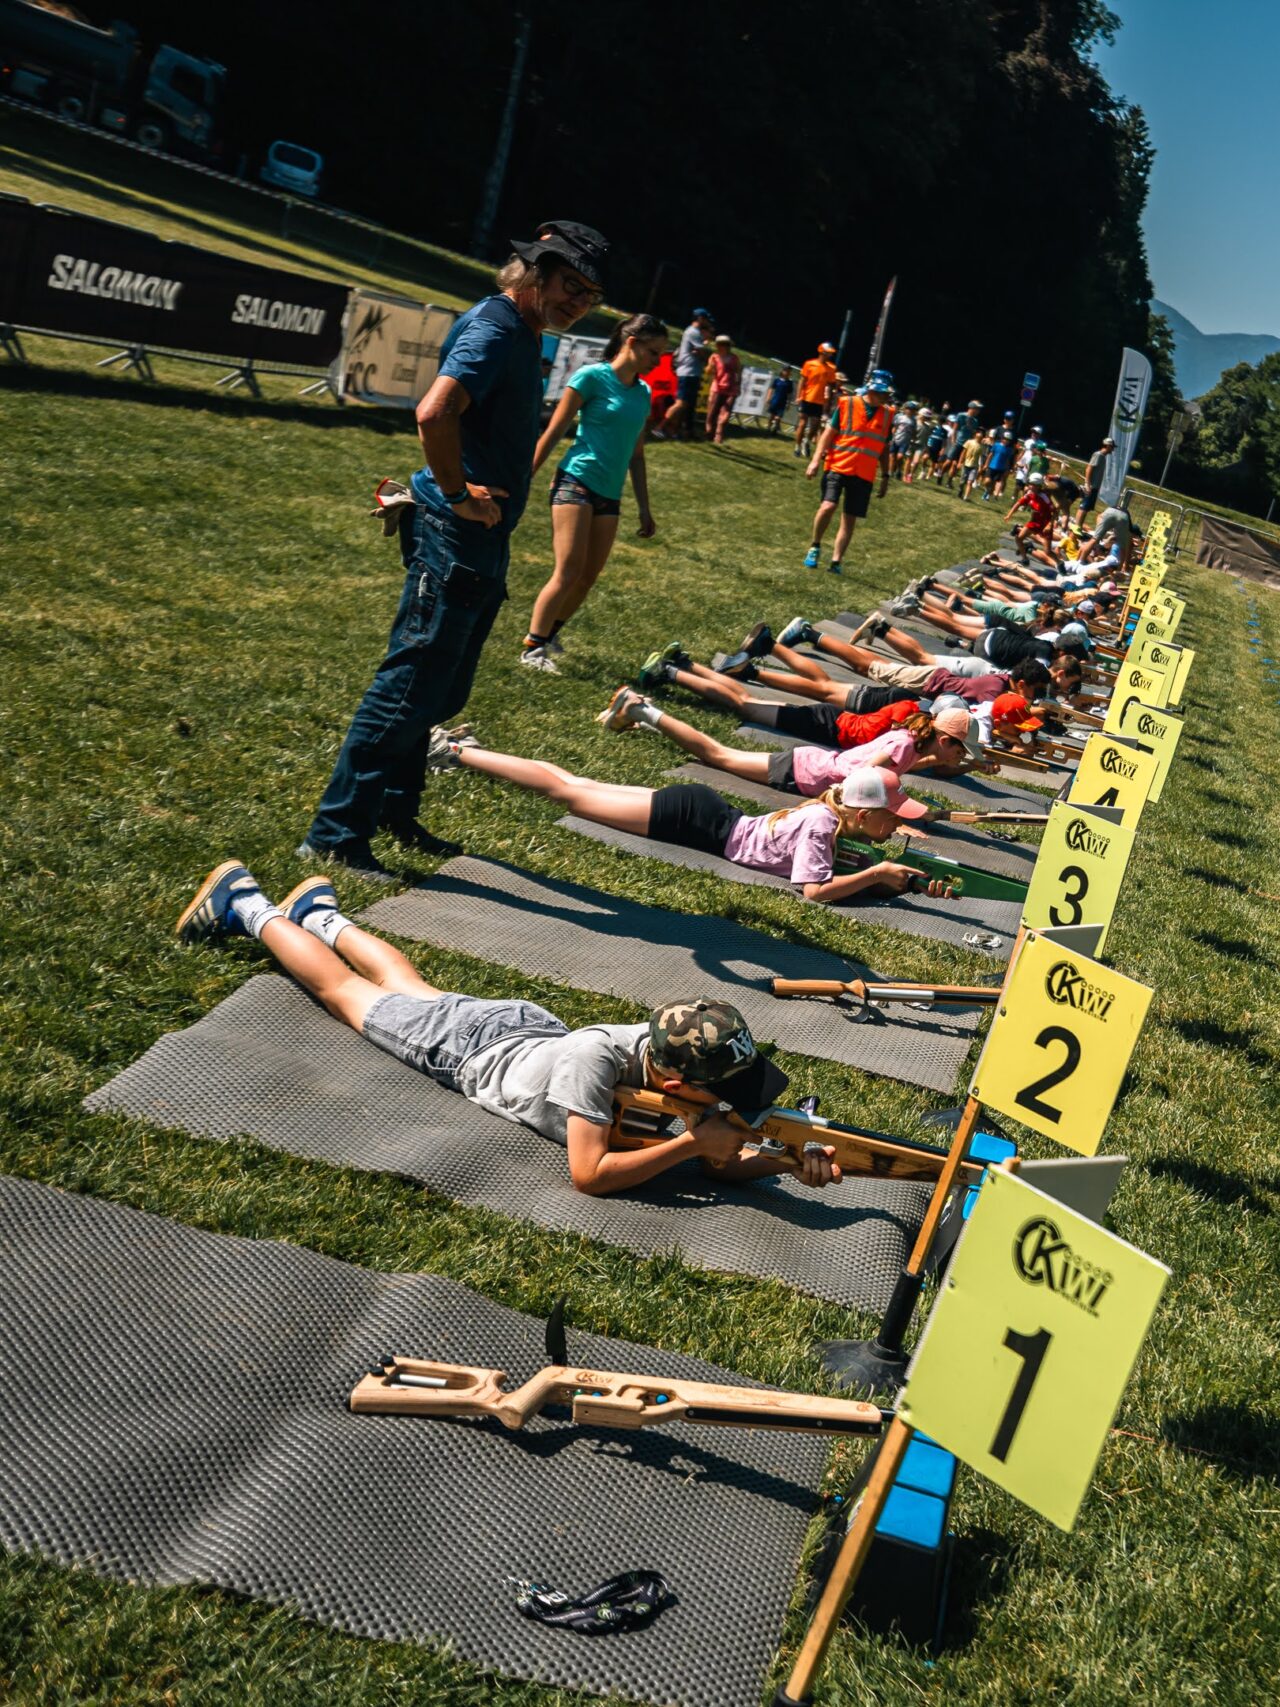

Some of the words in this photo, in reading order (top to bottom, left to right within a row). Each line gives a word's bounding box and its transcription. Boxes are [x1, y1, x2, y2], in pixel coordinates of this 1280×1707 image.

[48, 253, 182, 311] SALOMON
[231, 294, 326, 335] SALOMON
[1134, 588, 1150, 606] 14
[1049, 865, 1089, 927] 3
[1014, 1025, 1081, 1125] 2
[988, 1325, 1055, 1465] 1
